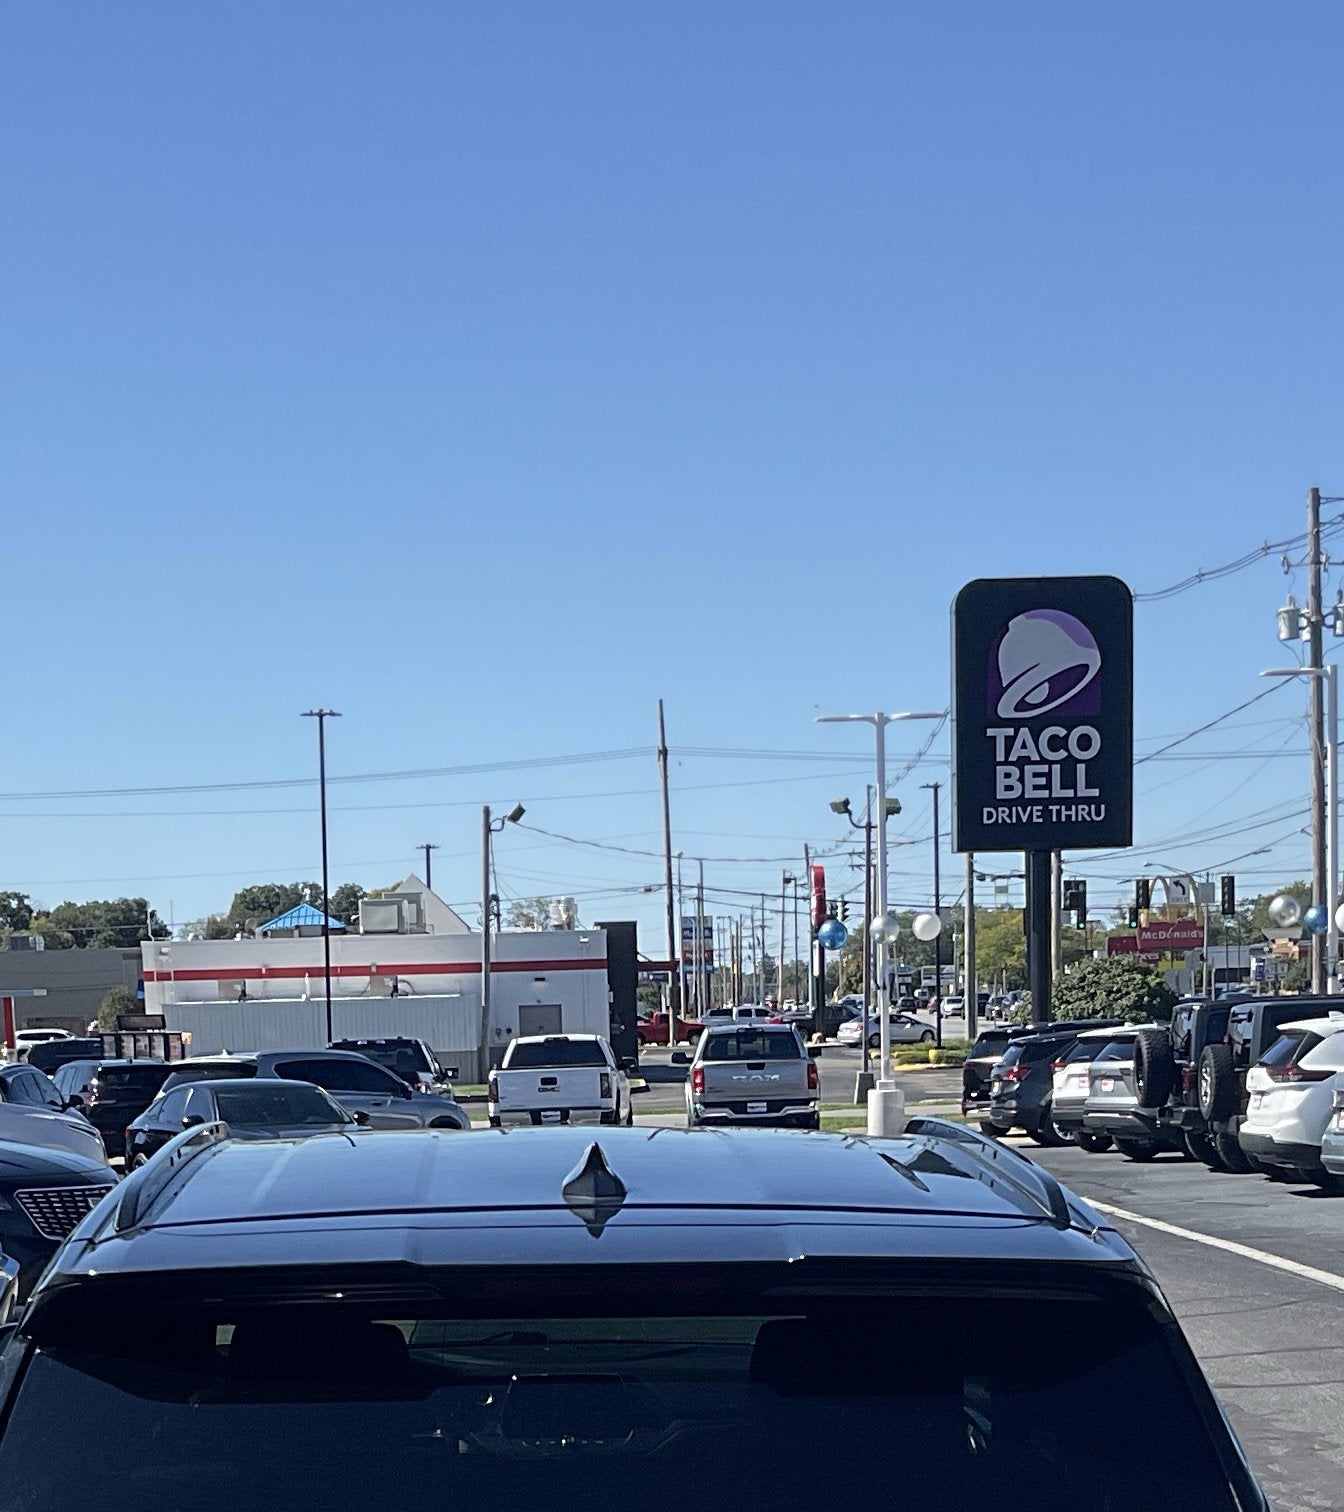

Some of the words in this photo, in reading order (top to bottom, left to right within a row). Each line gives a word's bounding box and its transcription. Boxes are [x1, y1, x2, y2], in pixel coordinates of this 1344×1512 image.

[986, 725, 1102, 763] TACO
[995, 763, 1100, 800] BELL
[982, 805, 1044, 824] DRIVE
[1048, 804, 1106, 823] THRU
